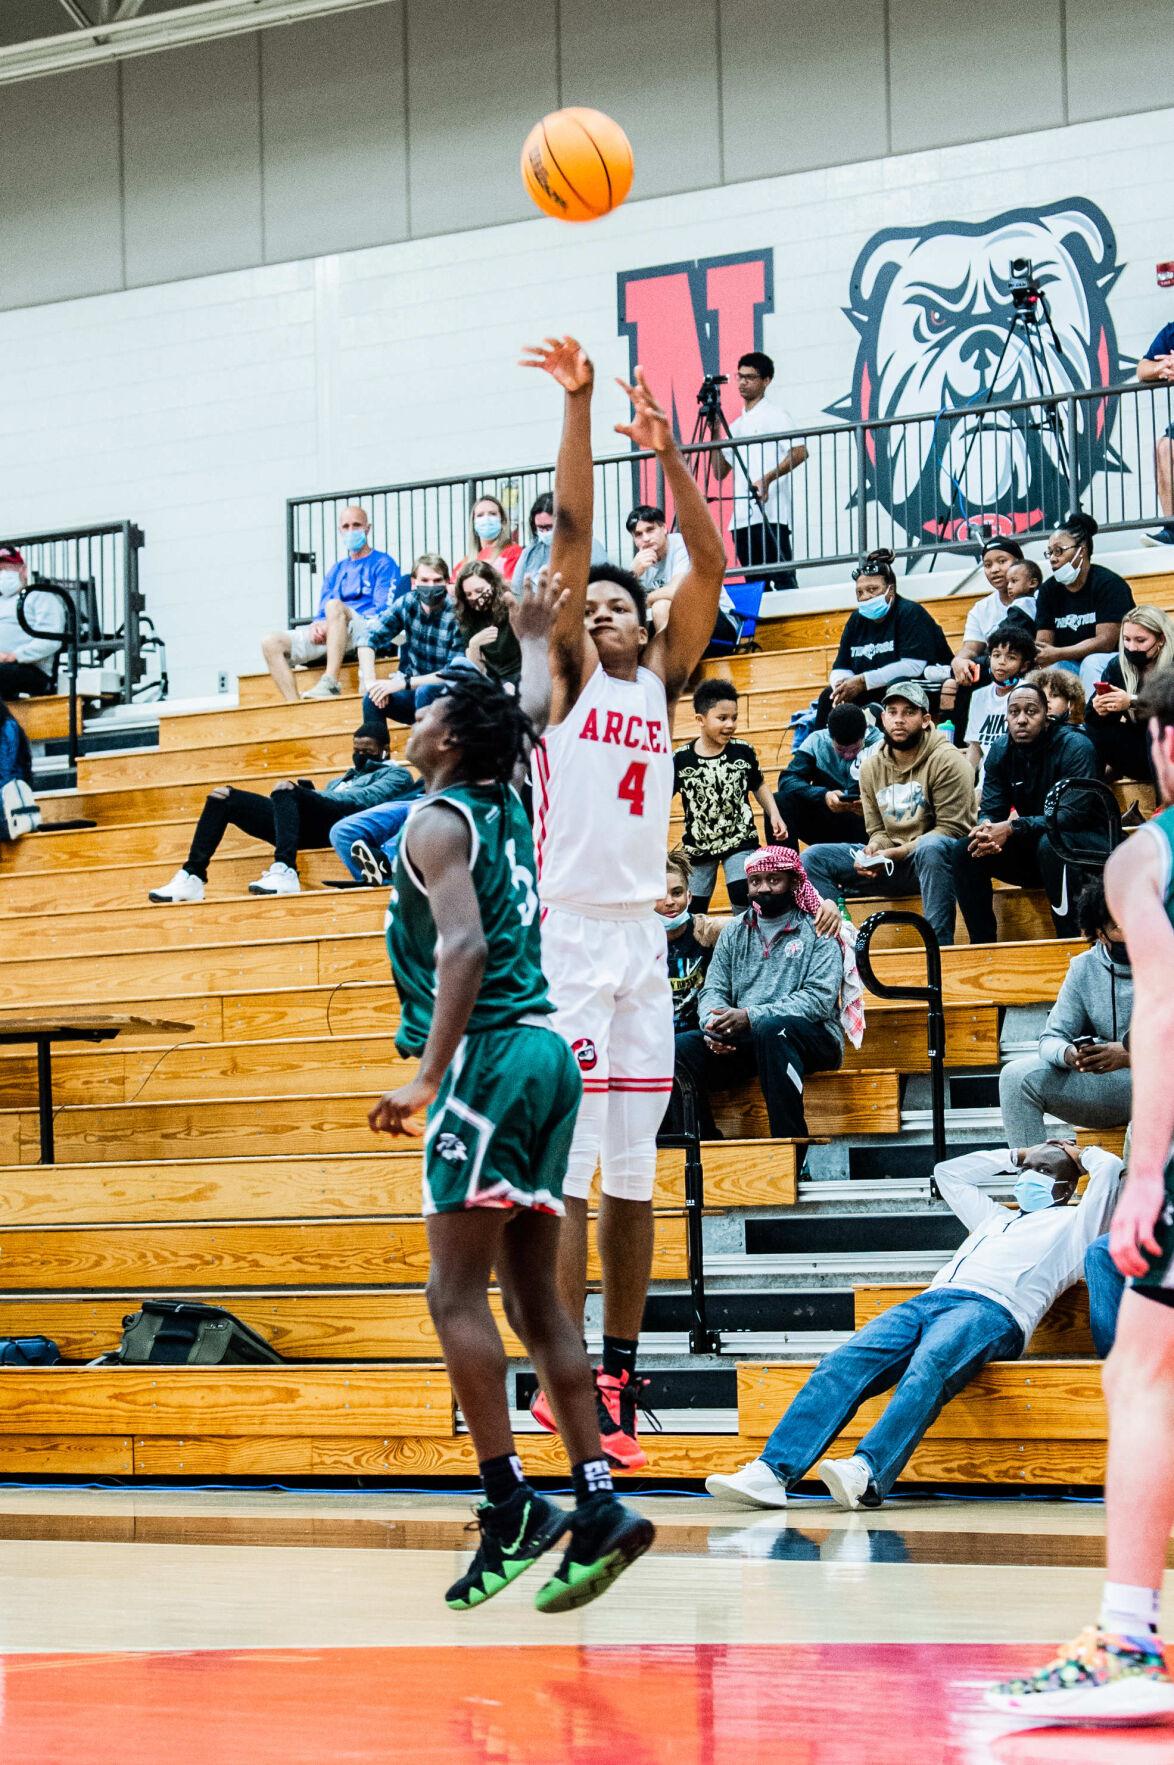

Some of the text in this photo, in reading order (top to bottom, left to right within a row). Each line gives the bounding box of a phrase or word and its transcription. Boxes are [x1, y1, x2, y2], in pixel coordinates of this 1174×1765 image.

[617, 247, 775, 585] N
[579, 707, 668, 754] ARCE
[979, 713, 1009, 735] NIK
[618, 760, 649, 817] 4
